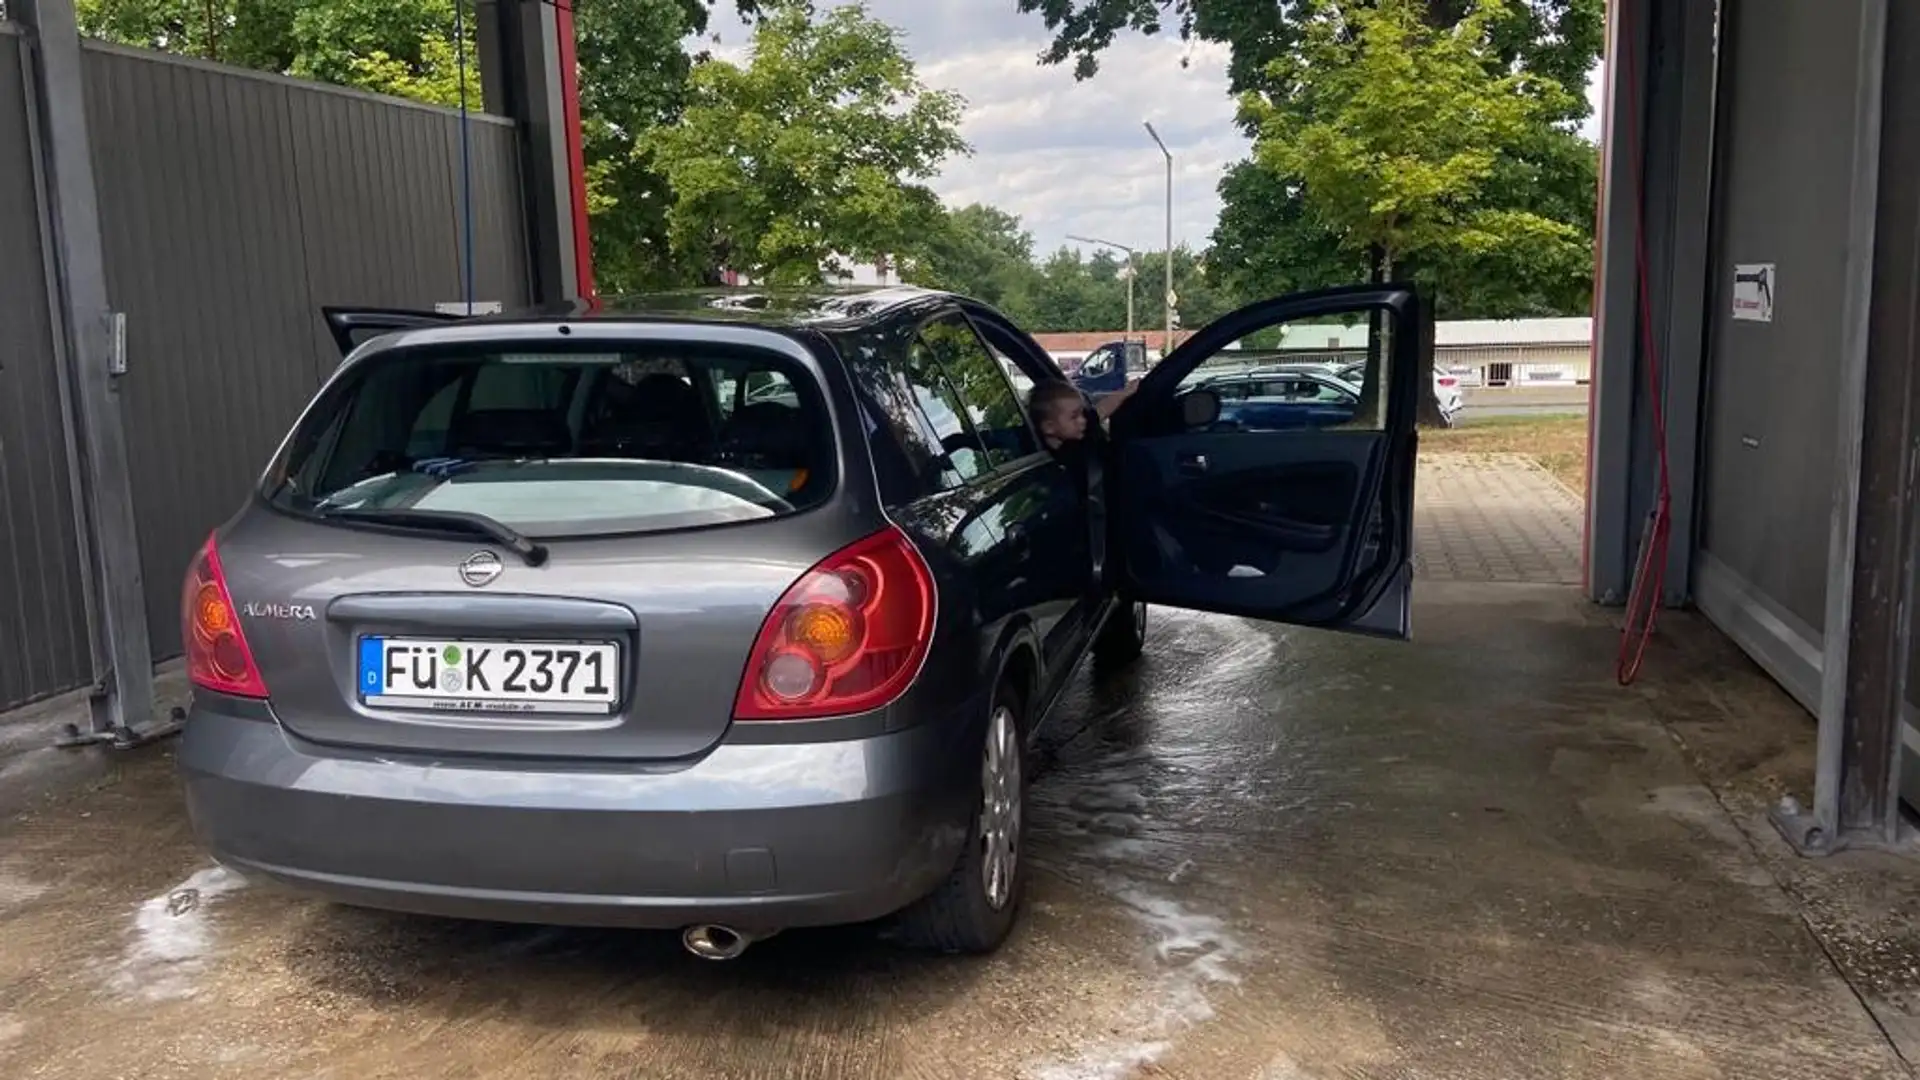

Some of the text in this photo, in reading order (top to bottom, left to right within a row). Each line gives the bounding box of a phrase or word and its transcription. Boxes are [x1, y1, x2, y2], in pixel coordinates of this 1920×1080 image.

[243, 603, 317, 620] ALMERA
[367, 670, 377, 685] D
[386, 646, 609, 694] FÜ K 2371
